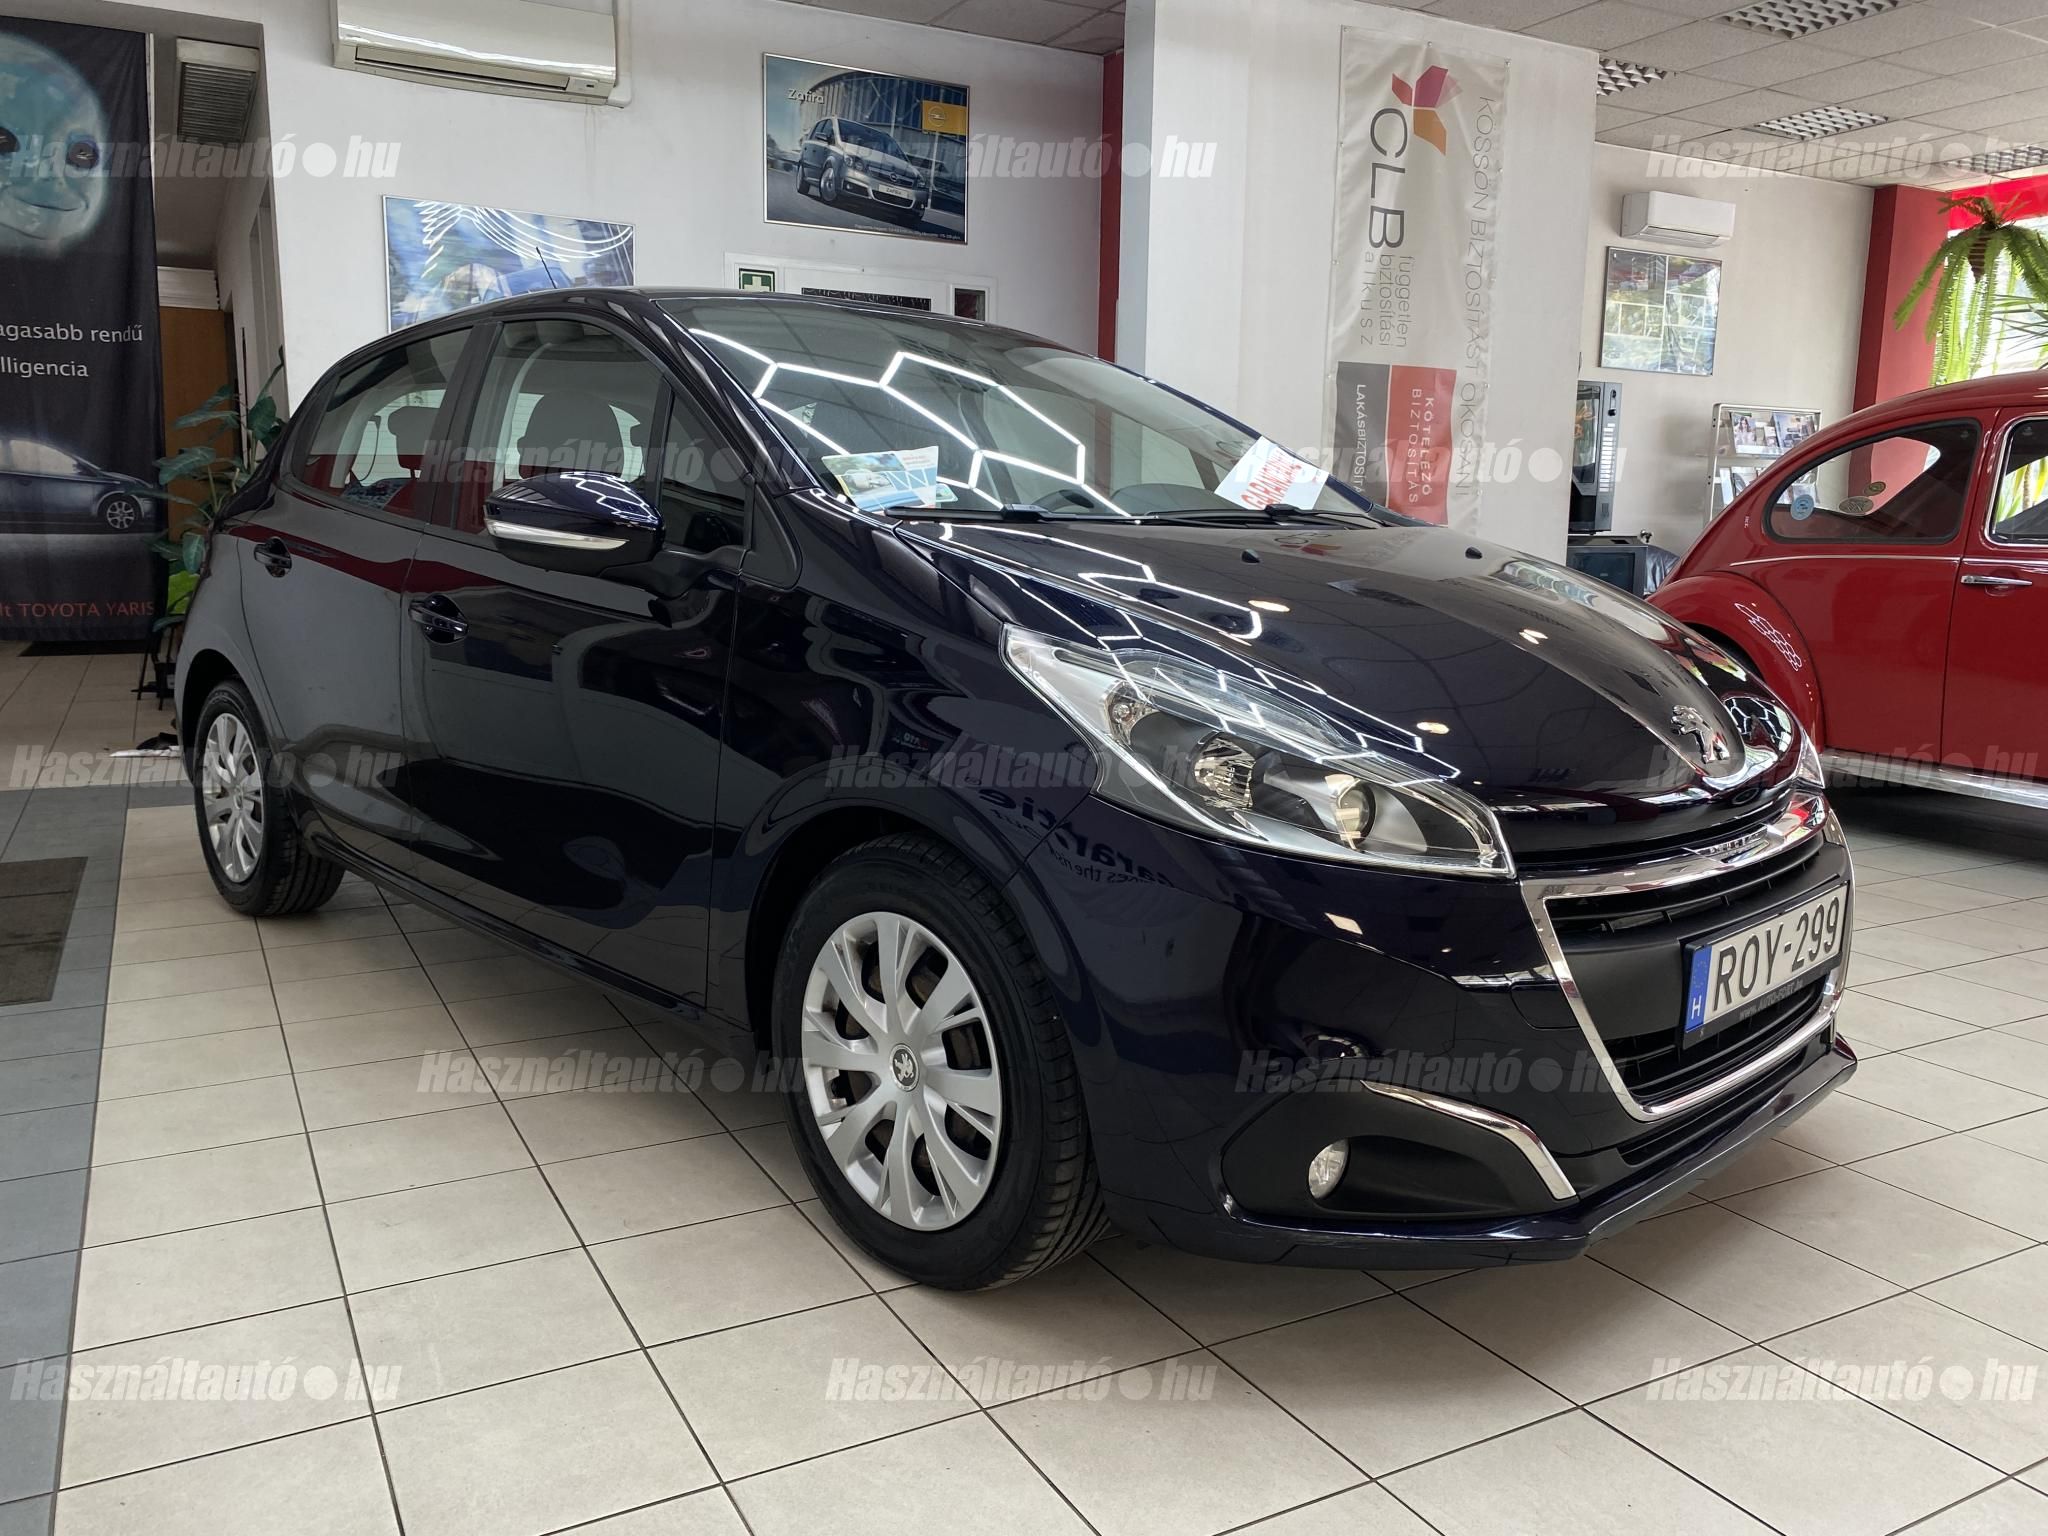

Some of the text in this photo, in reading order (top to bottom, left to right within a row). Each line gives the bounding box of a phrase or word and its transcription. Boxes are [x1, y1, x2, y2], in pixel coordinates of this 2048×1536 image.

[788, 88, 825, 104] Zafira
[1369, 107, 1408, 249] CLB
[90, 324, 144, 343] rendű
[1407, 388, 1423, 504] BIZTOSÍTÁS
[16, 602, 101, 617] TOYOTA
[106, 601, 155, 616] YARIS
[1713, 896, 1840, 1011] ROY-299
[1691, 995, 1703, 1020] H
